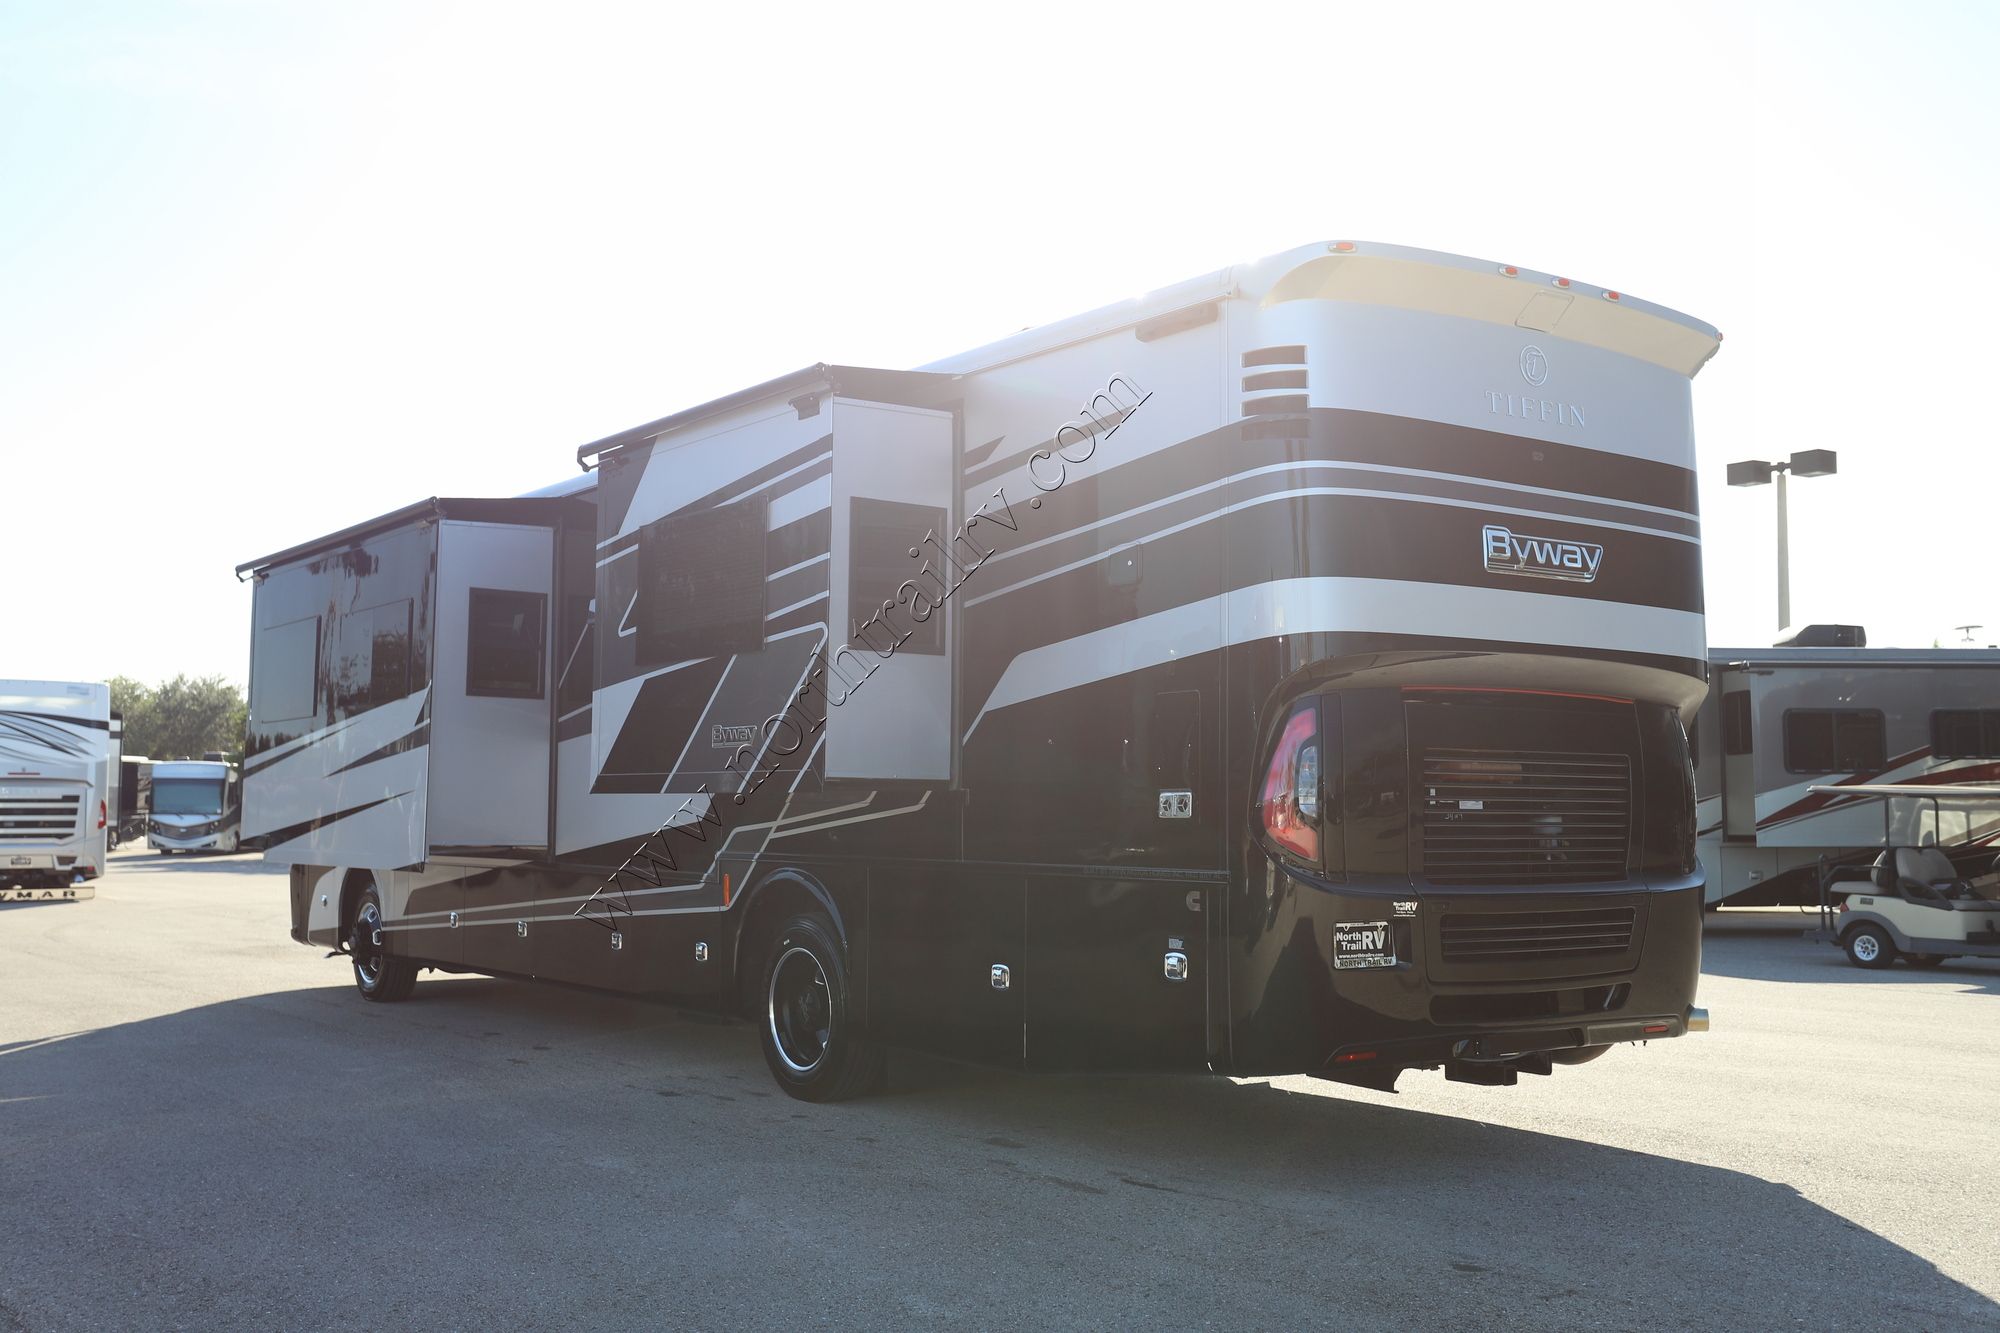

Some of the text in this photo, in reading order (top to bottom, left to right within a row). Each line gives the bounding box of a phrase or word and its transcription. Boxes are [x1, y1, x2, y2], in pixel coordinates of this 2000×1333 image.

[1485, 390, 1585, 428] TIFFIN
[1486, 528, 1601, 577] Byway
[713, 727, 755, 745] Byway
[1406, 902, 1417, 910] RV
[1336, 931, 1361, 941] North
[1361, 931, 1385, 950] RV
[1341, 941, 1361, 950] Trail
[1339, 957, 1393, 967] NORTH TRAIL RV
